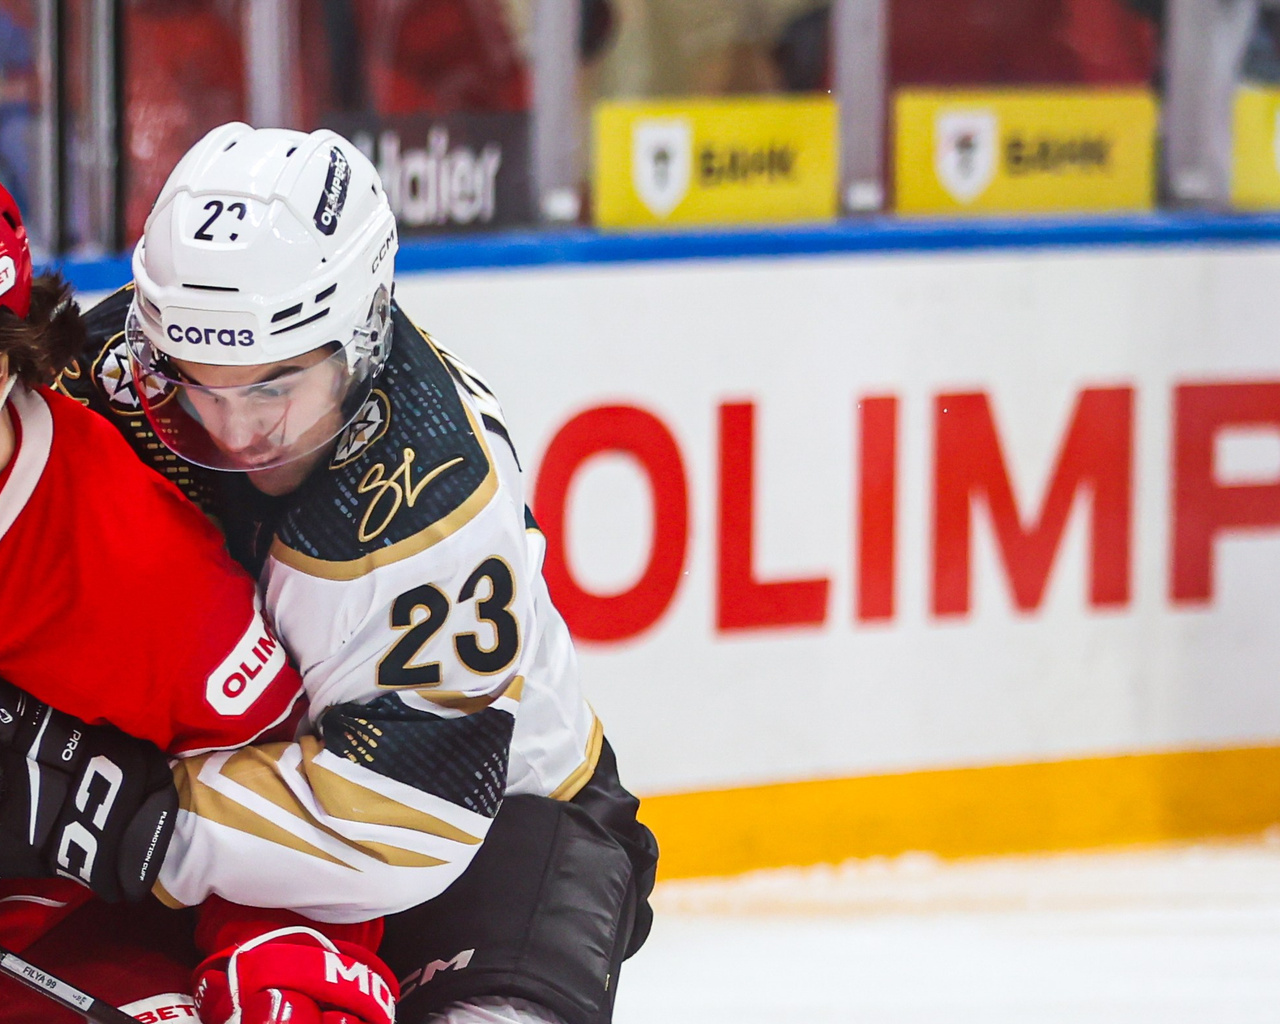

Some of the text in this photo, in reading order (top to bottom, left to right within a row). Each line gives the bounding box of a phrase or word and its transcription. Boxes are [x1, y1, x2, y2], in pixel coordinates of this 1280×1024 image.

[372, 229, 395, 274] CCM
[167, 324, 255, 347] согаз
[530, 377, 1280, 651] OLIMP
[375, 553, 522, 689] 23
[61, 729, 83, 762] PRO
[55, 754, 124, 891] CC
[139, 810, 168, 881] FLEXMOTION CUFF
[23, 966, 57, 989] FILYA 99
